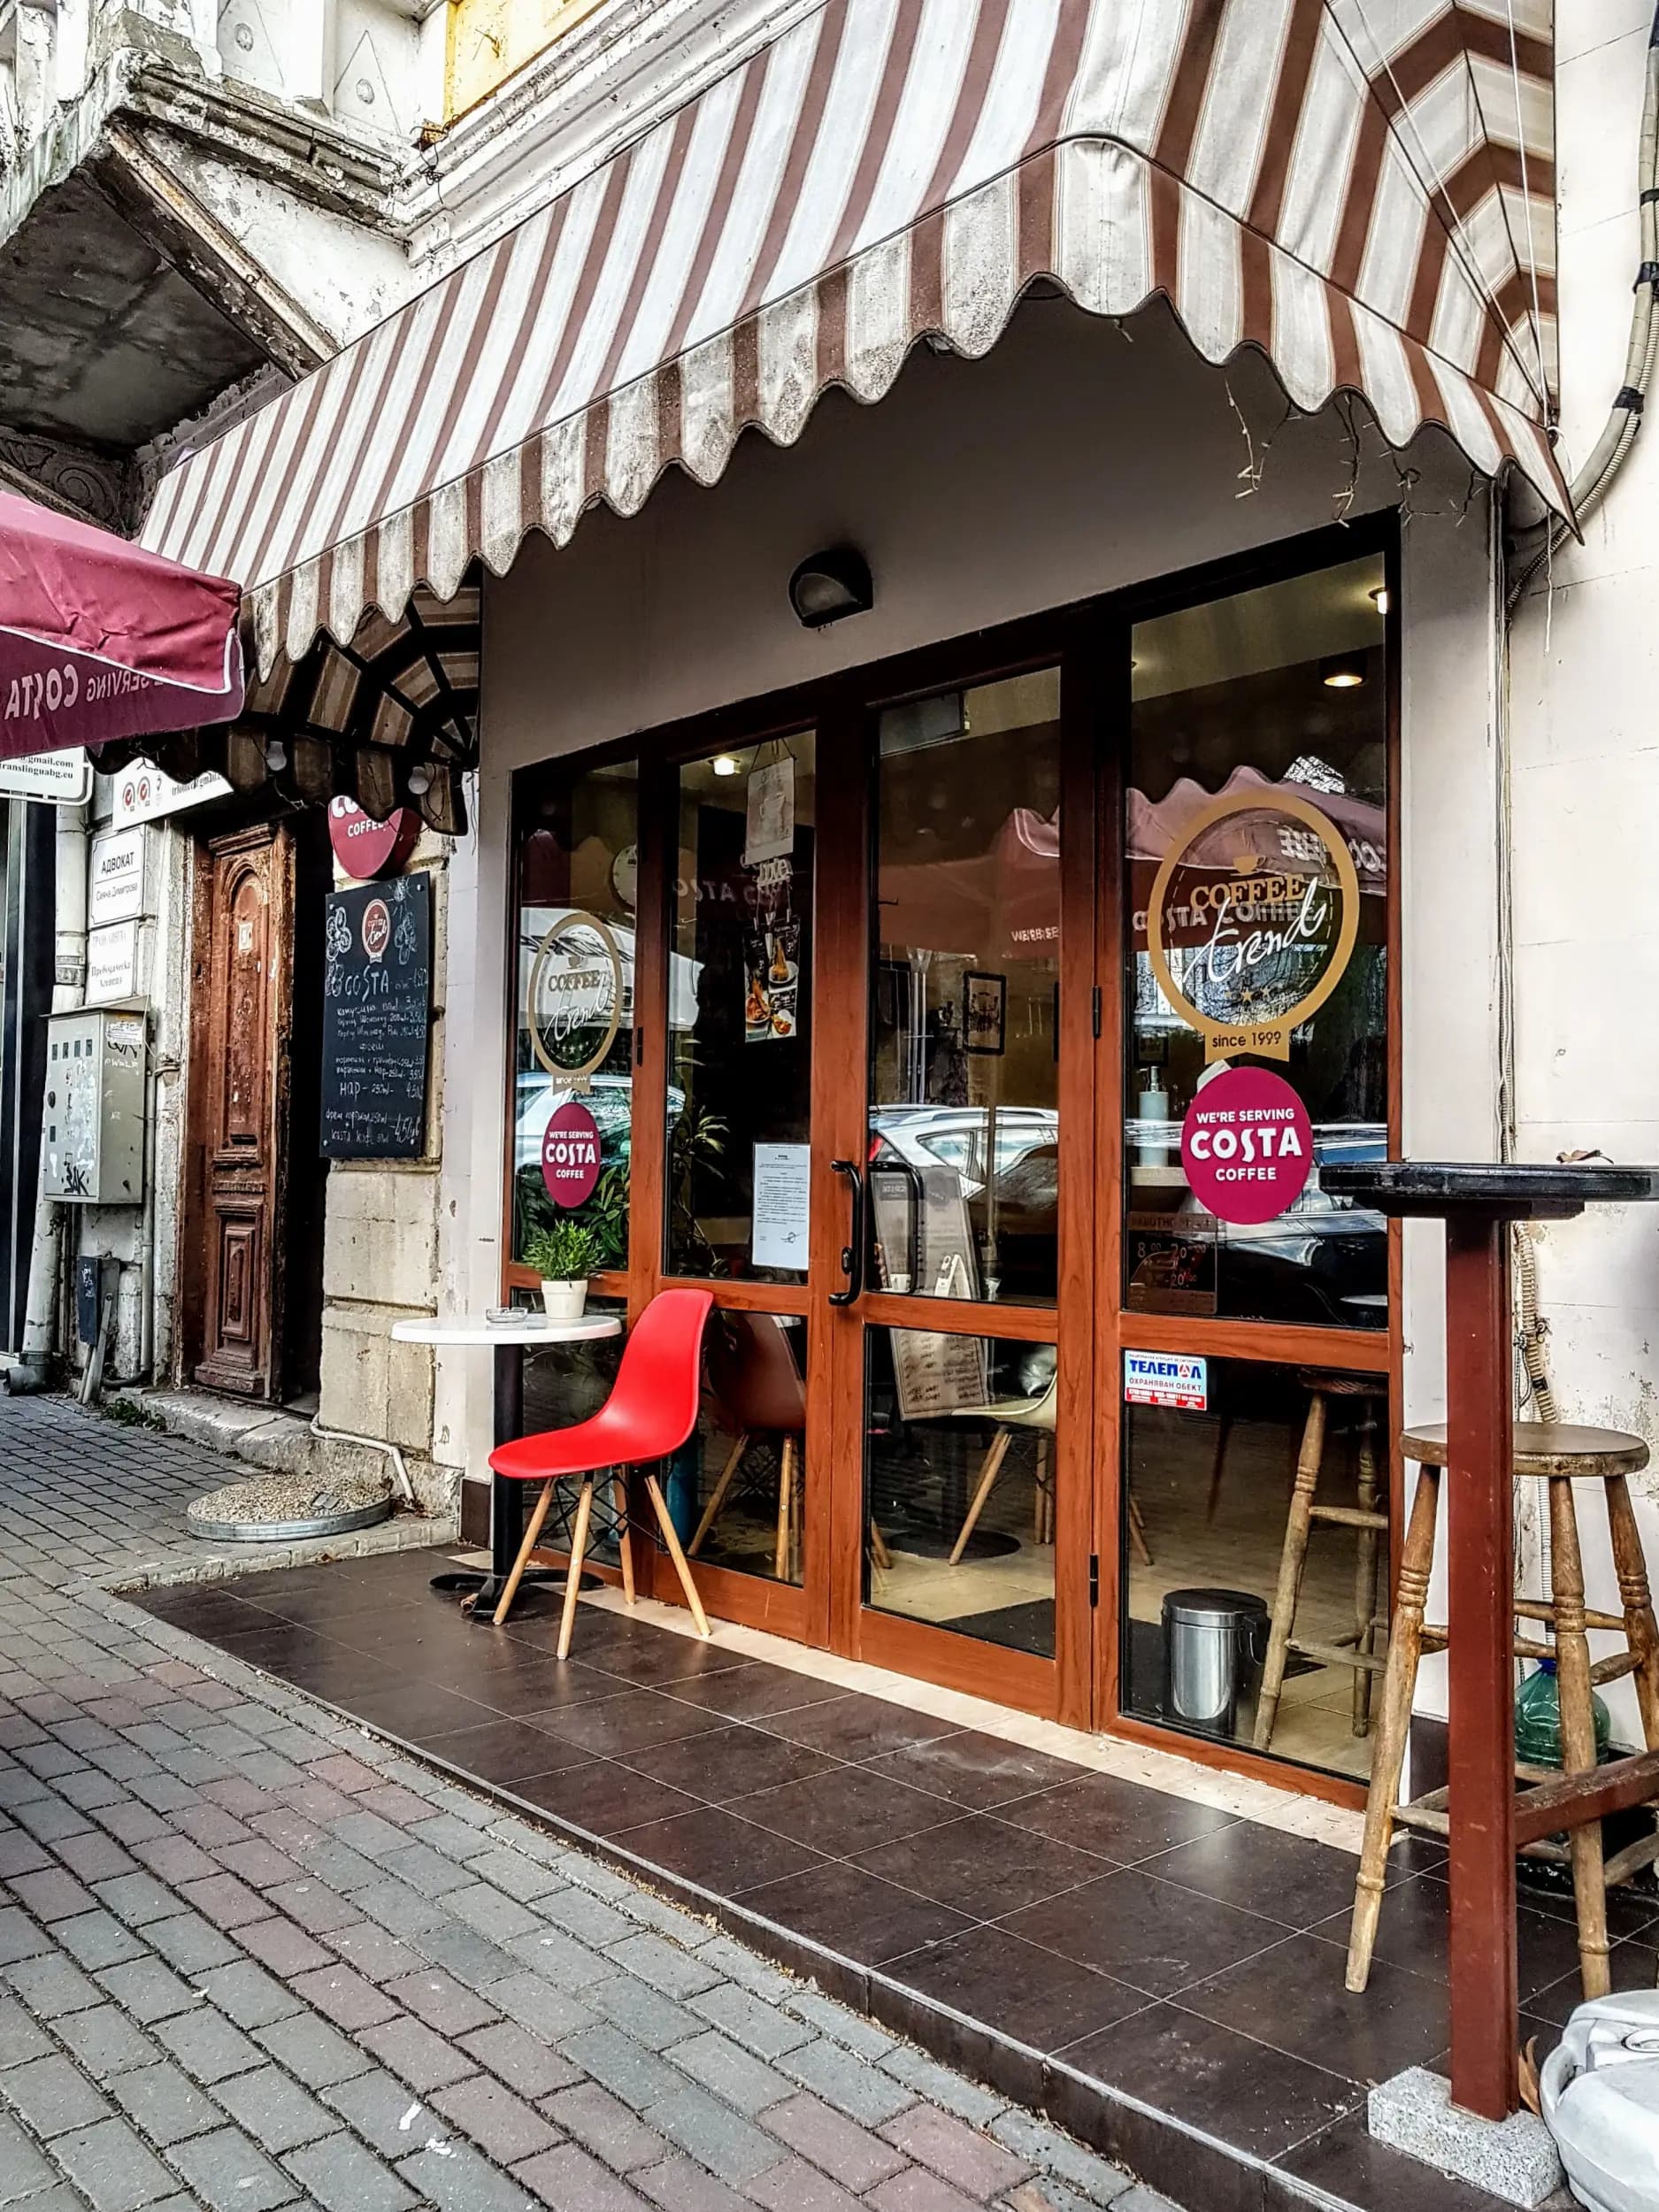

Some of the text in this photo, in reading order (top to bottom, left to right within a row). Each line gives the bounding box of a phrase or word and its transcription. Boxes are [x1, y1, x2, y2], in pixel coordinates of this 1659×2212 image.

[102, 851, 134, 874] АДВОКАТ
[1190, 873, 1307, 911] COFFEE
[549, 969, 601, 992] COFFEE
[1212, 1031, 1282, 1048] since 1999
[1196, 1107, 1295, 1125] WE'RE SERVING
[549, 1131, 594, 1140] WE'RE SERVING
[1190, 1126, 1302, 1163] COSTA
[545, 1142, 596, 1167] COSTA
[556, 1169, 585, 1179] COFFEE
[1216, 1167, 1277, 1181] COFFEE
[1129, 1377, 1202, 1392] ОХРАНЯВАН ОБЕКТ
